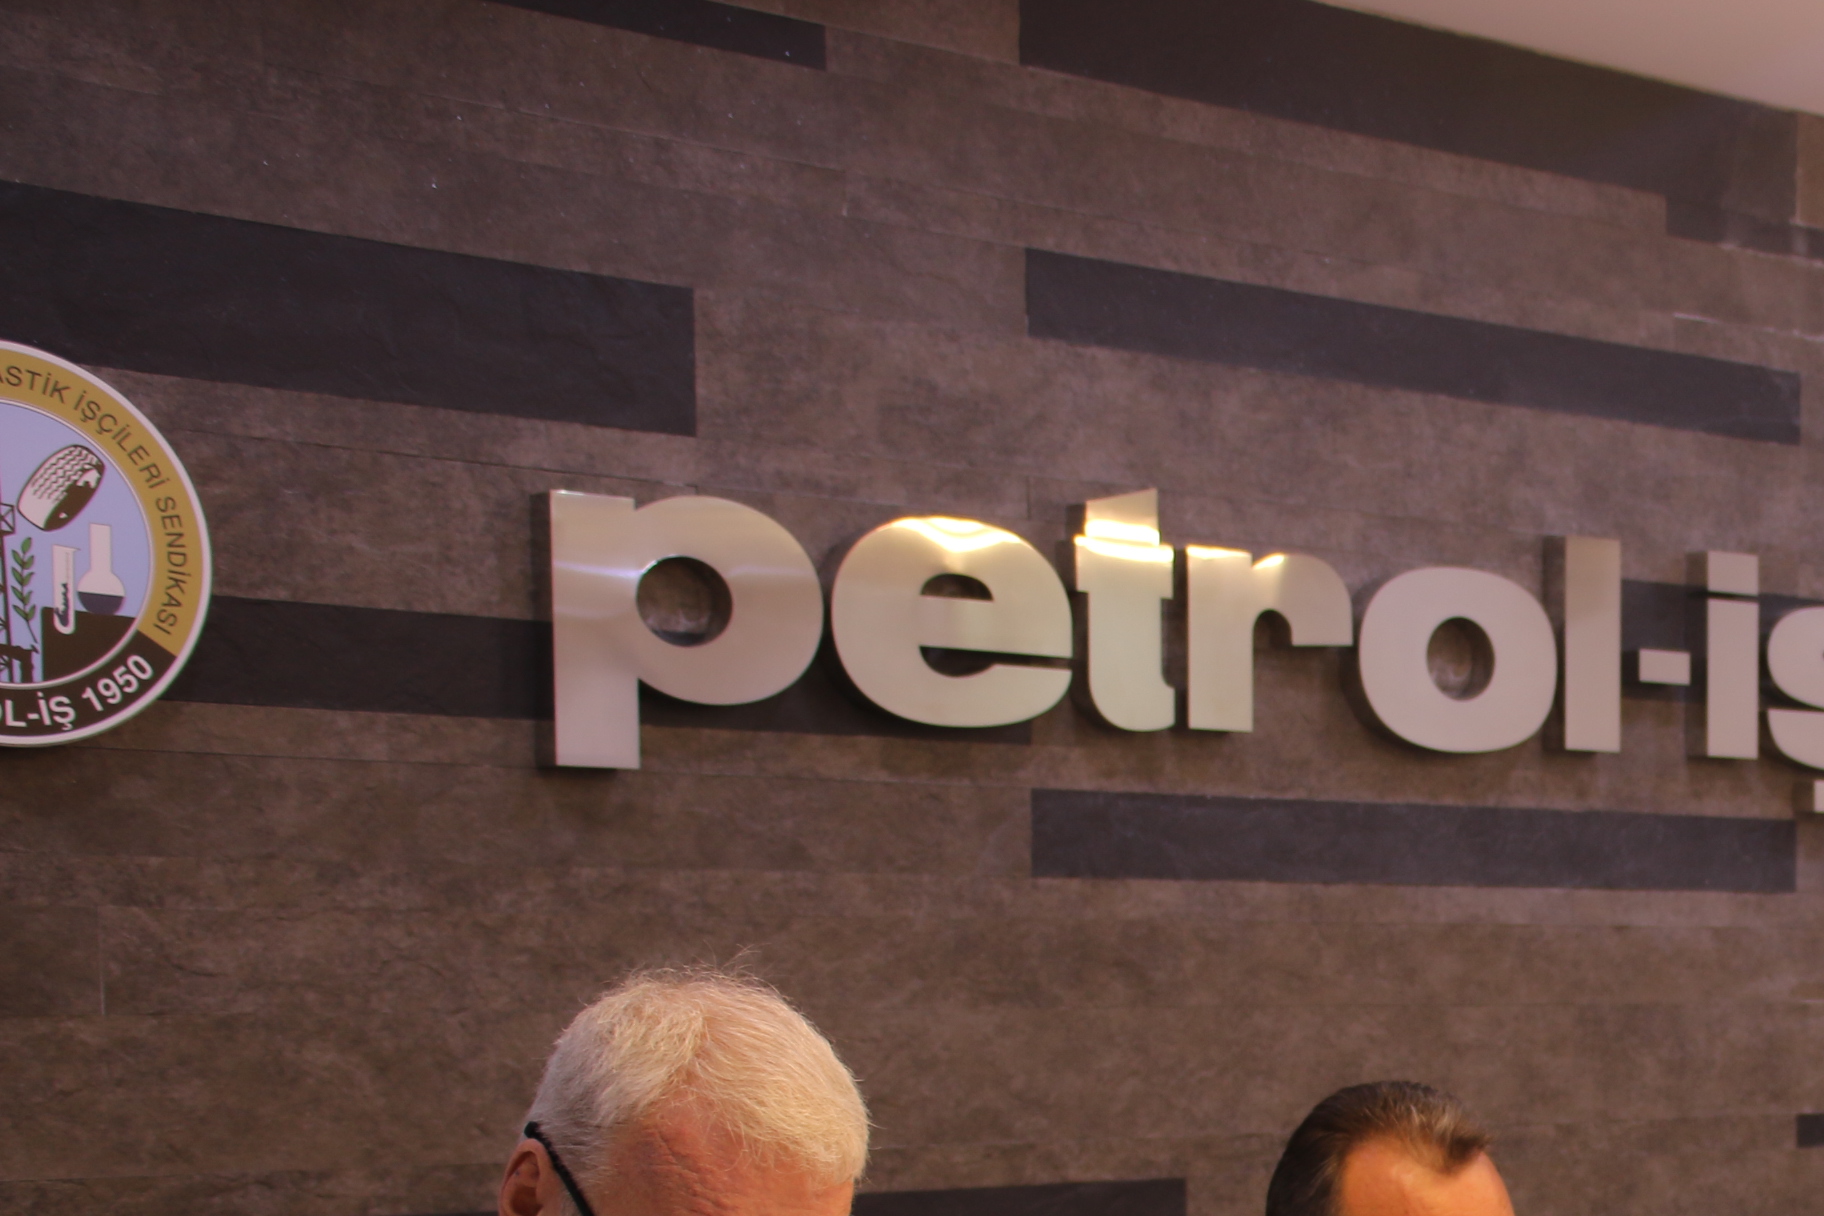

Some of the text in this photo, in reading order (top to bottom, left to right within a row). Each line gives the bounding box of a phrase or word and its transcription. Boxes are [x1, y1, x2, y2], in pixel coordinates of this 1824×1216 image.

[0, 365, 193, 636] STİK İŞÇİLERİ SENDİKASI
[0, 654, 155, 731] L-İŞ 1950
